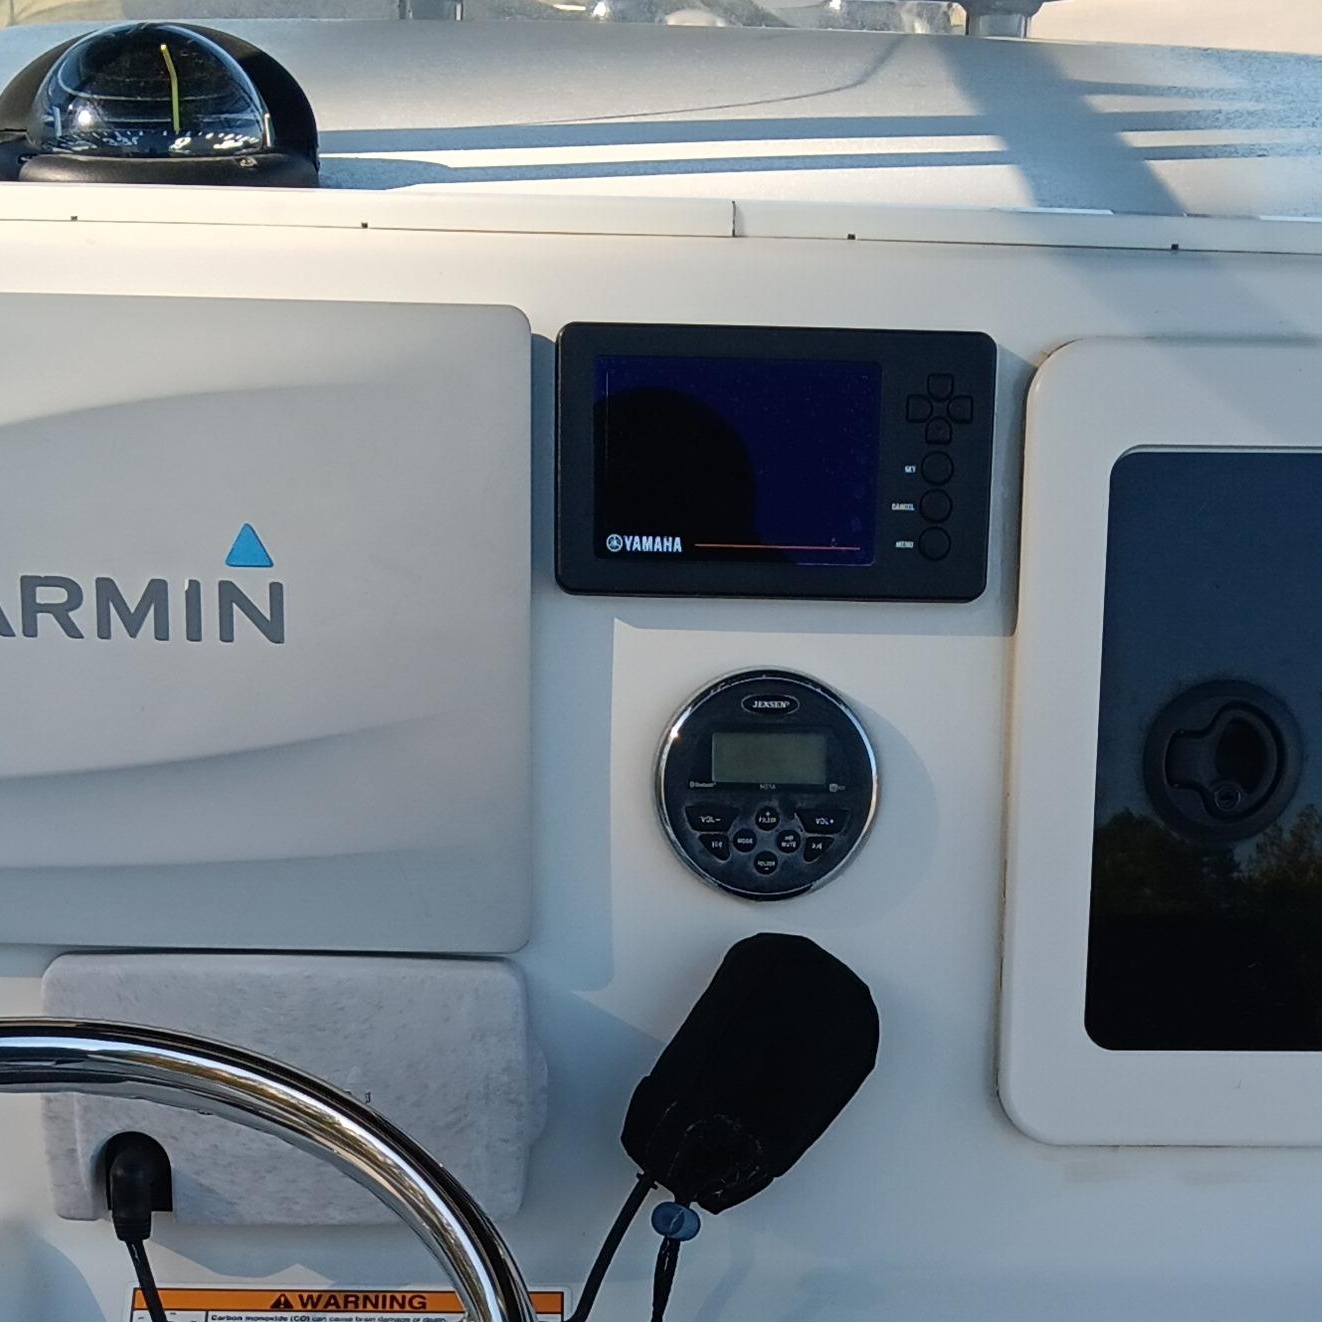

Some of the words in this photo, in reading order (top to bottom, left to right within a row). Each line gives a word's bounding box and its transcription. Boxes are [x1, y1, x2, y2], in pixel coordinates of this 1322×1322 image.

[891, 503, 915, 511] CANCEL
[623, 535, 682, 552] YAMAHA
[895, 541, 914, 549] MENU
[298, 1294, 427, 1310] WARNING
